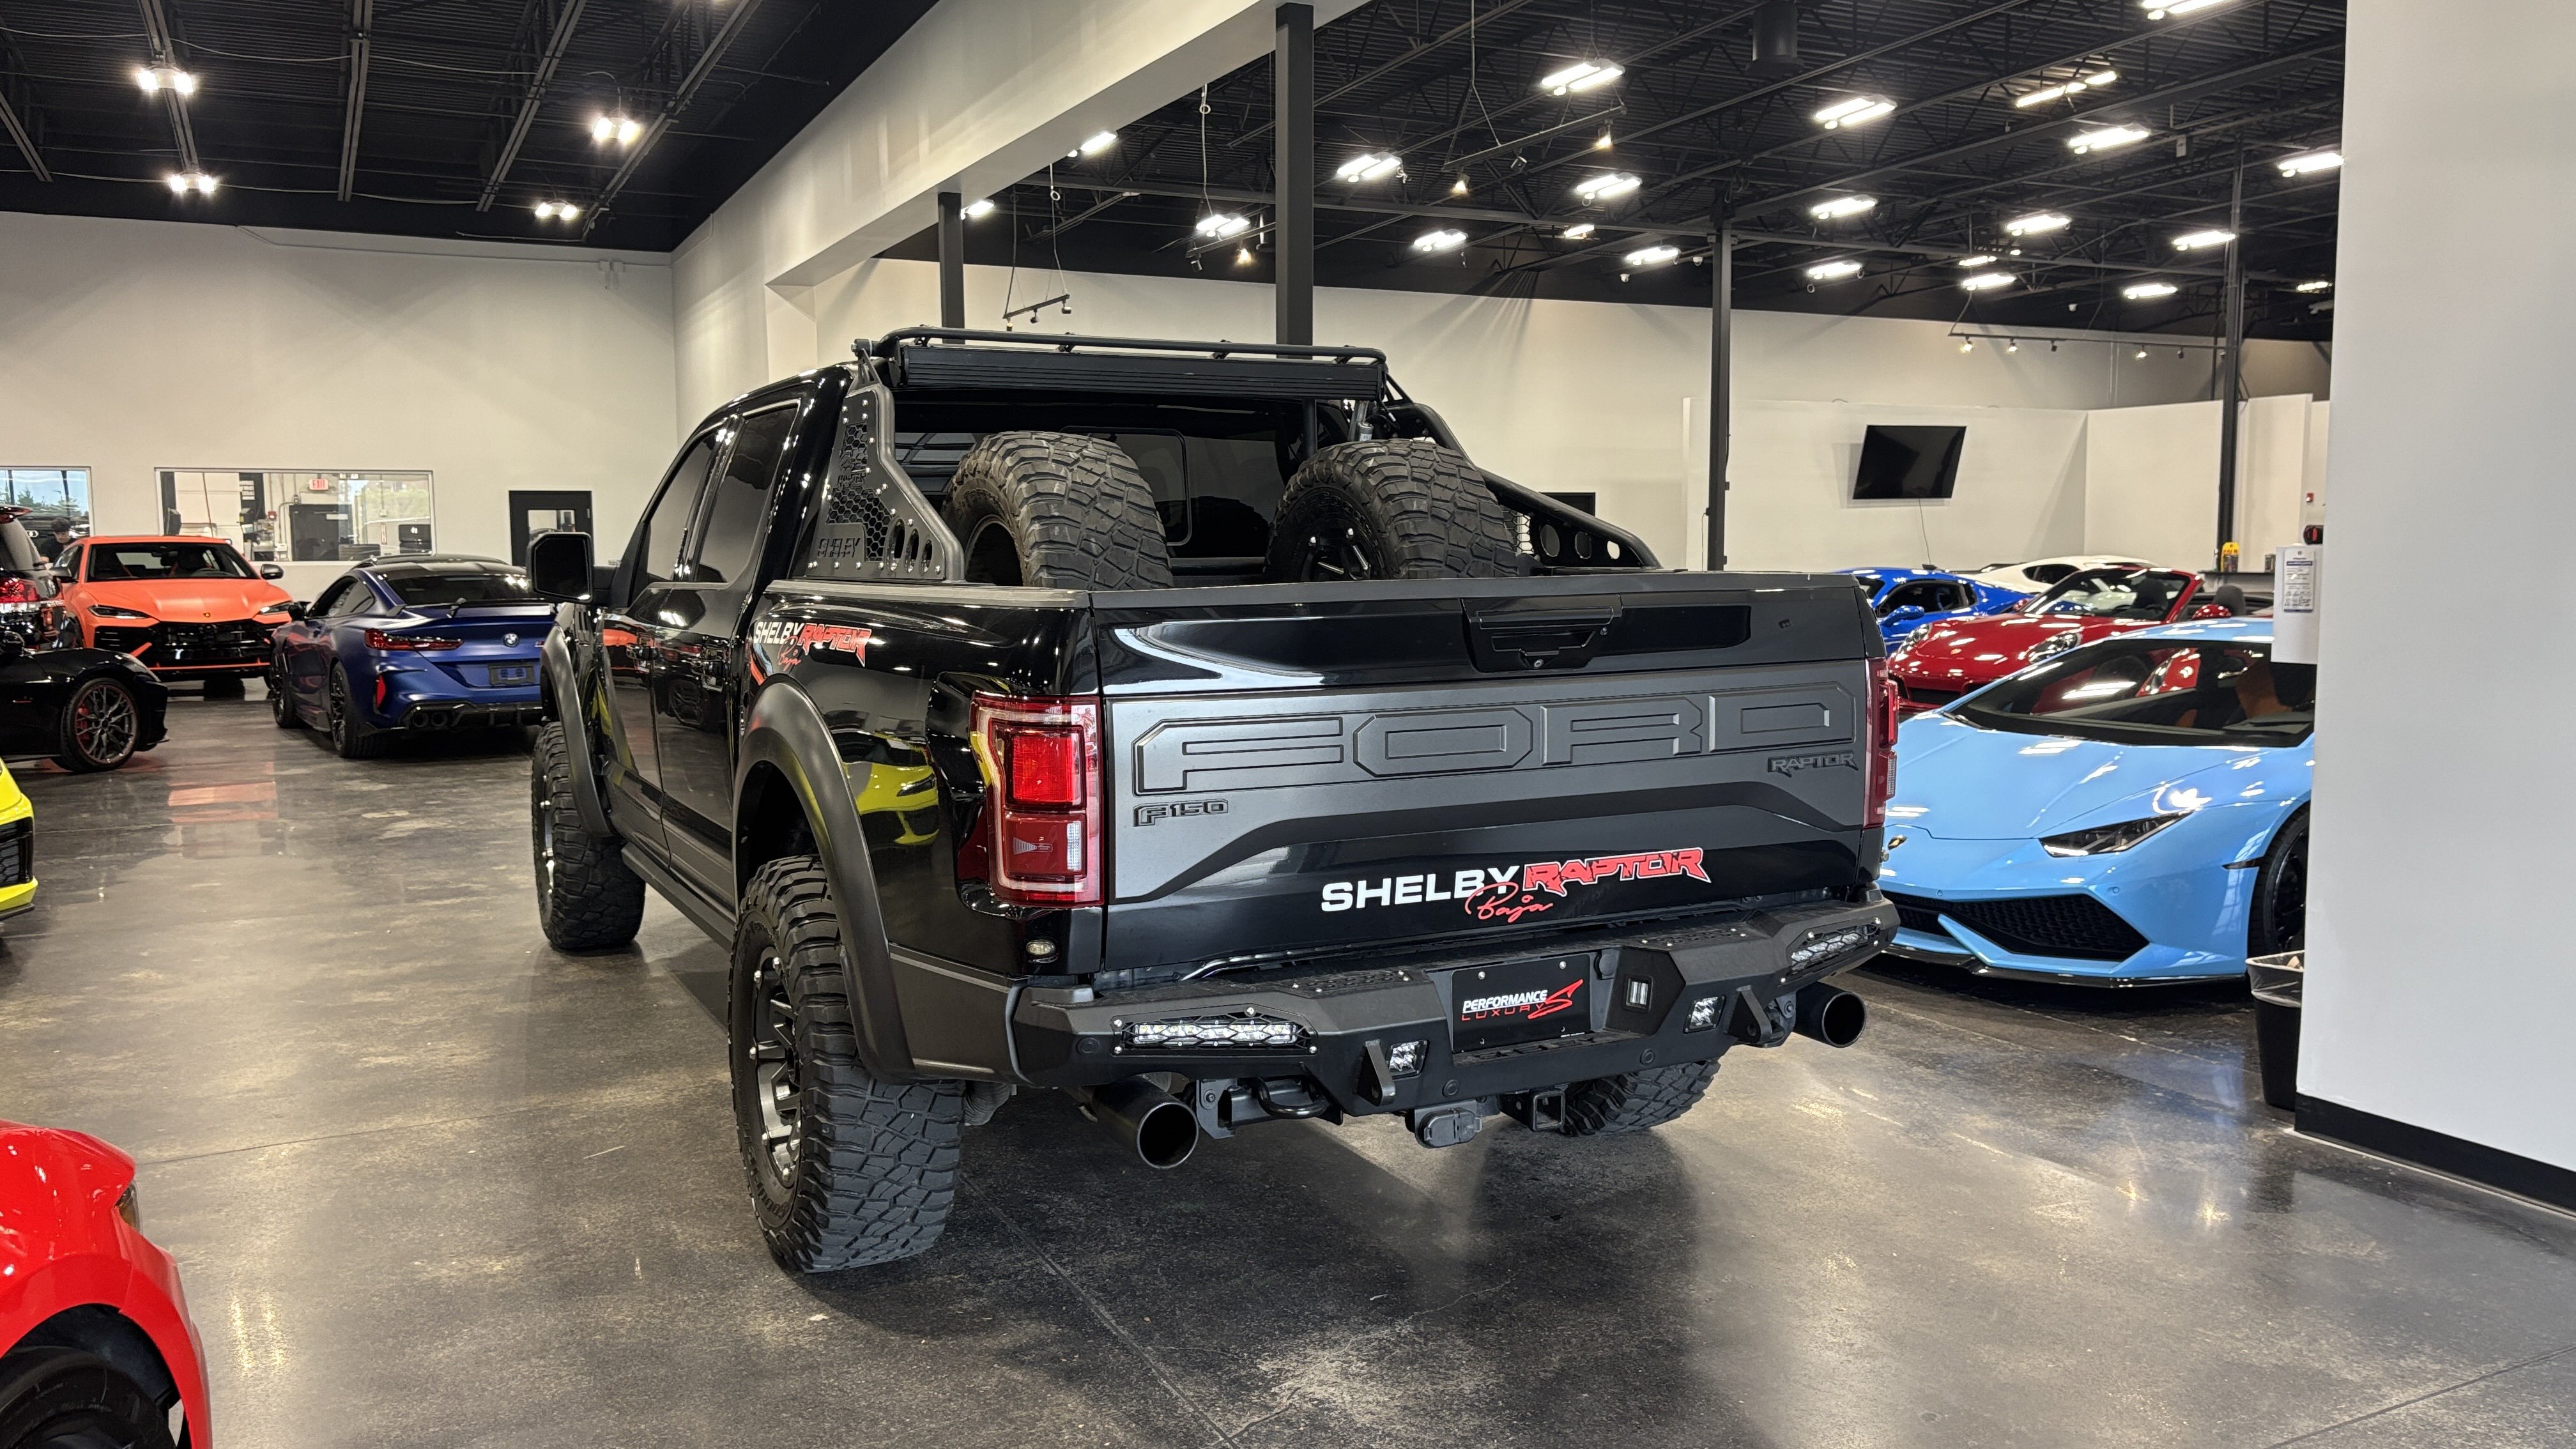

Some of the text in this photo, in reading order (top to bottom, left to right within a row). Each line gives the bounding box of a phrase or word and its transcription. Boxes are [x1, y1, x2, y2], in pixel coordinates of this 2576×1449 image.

[312, 480, 325, 489] EXIT
[753, 622, 872, 668] SHELBY RAPTOR
[778, 636, 801, 671] Baja
[1132, 682, 1855, 796] FORD
[1768, 750, 1859, 778] RAPTOR
[1321, 847, 1712, 912] SHELBY RAPTOR
[1464, 881, 1554, 923] Baja
[1461, 1003, 1546, 1022] LUXURY
[1462, 990, 1548, 1013] PERFORMANCE
